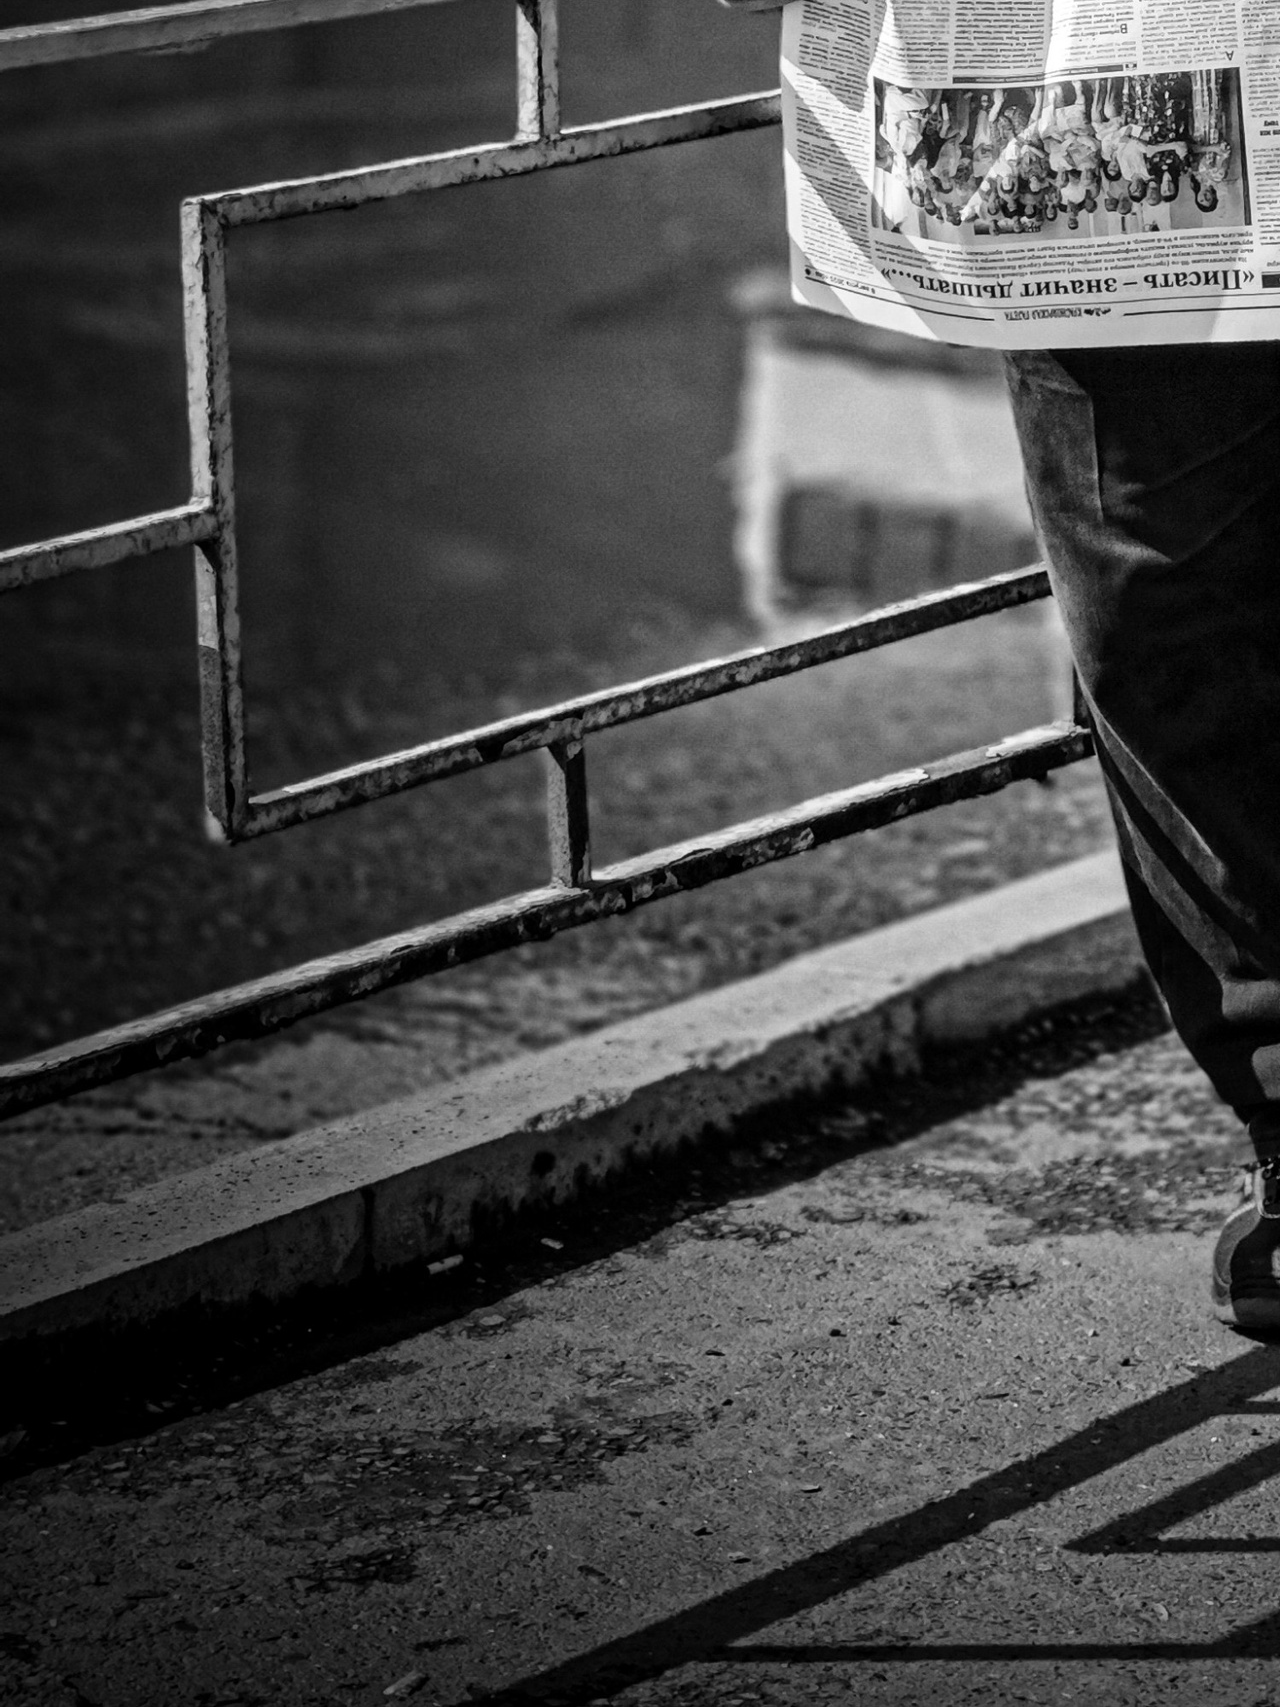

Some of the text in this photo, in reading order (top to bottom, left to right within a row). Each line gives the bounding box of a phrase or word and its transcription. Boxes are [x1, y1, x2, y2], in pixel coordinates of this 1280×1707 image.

[1020, 278, 1117, 297] значит
[1144, 269, 1255, 290] «Писать
[1004, 311, 1029, 320] ГАЗЕТА
